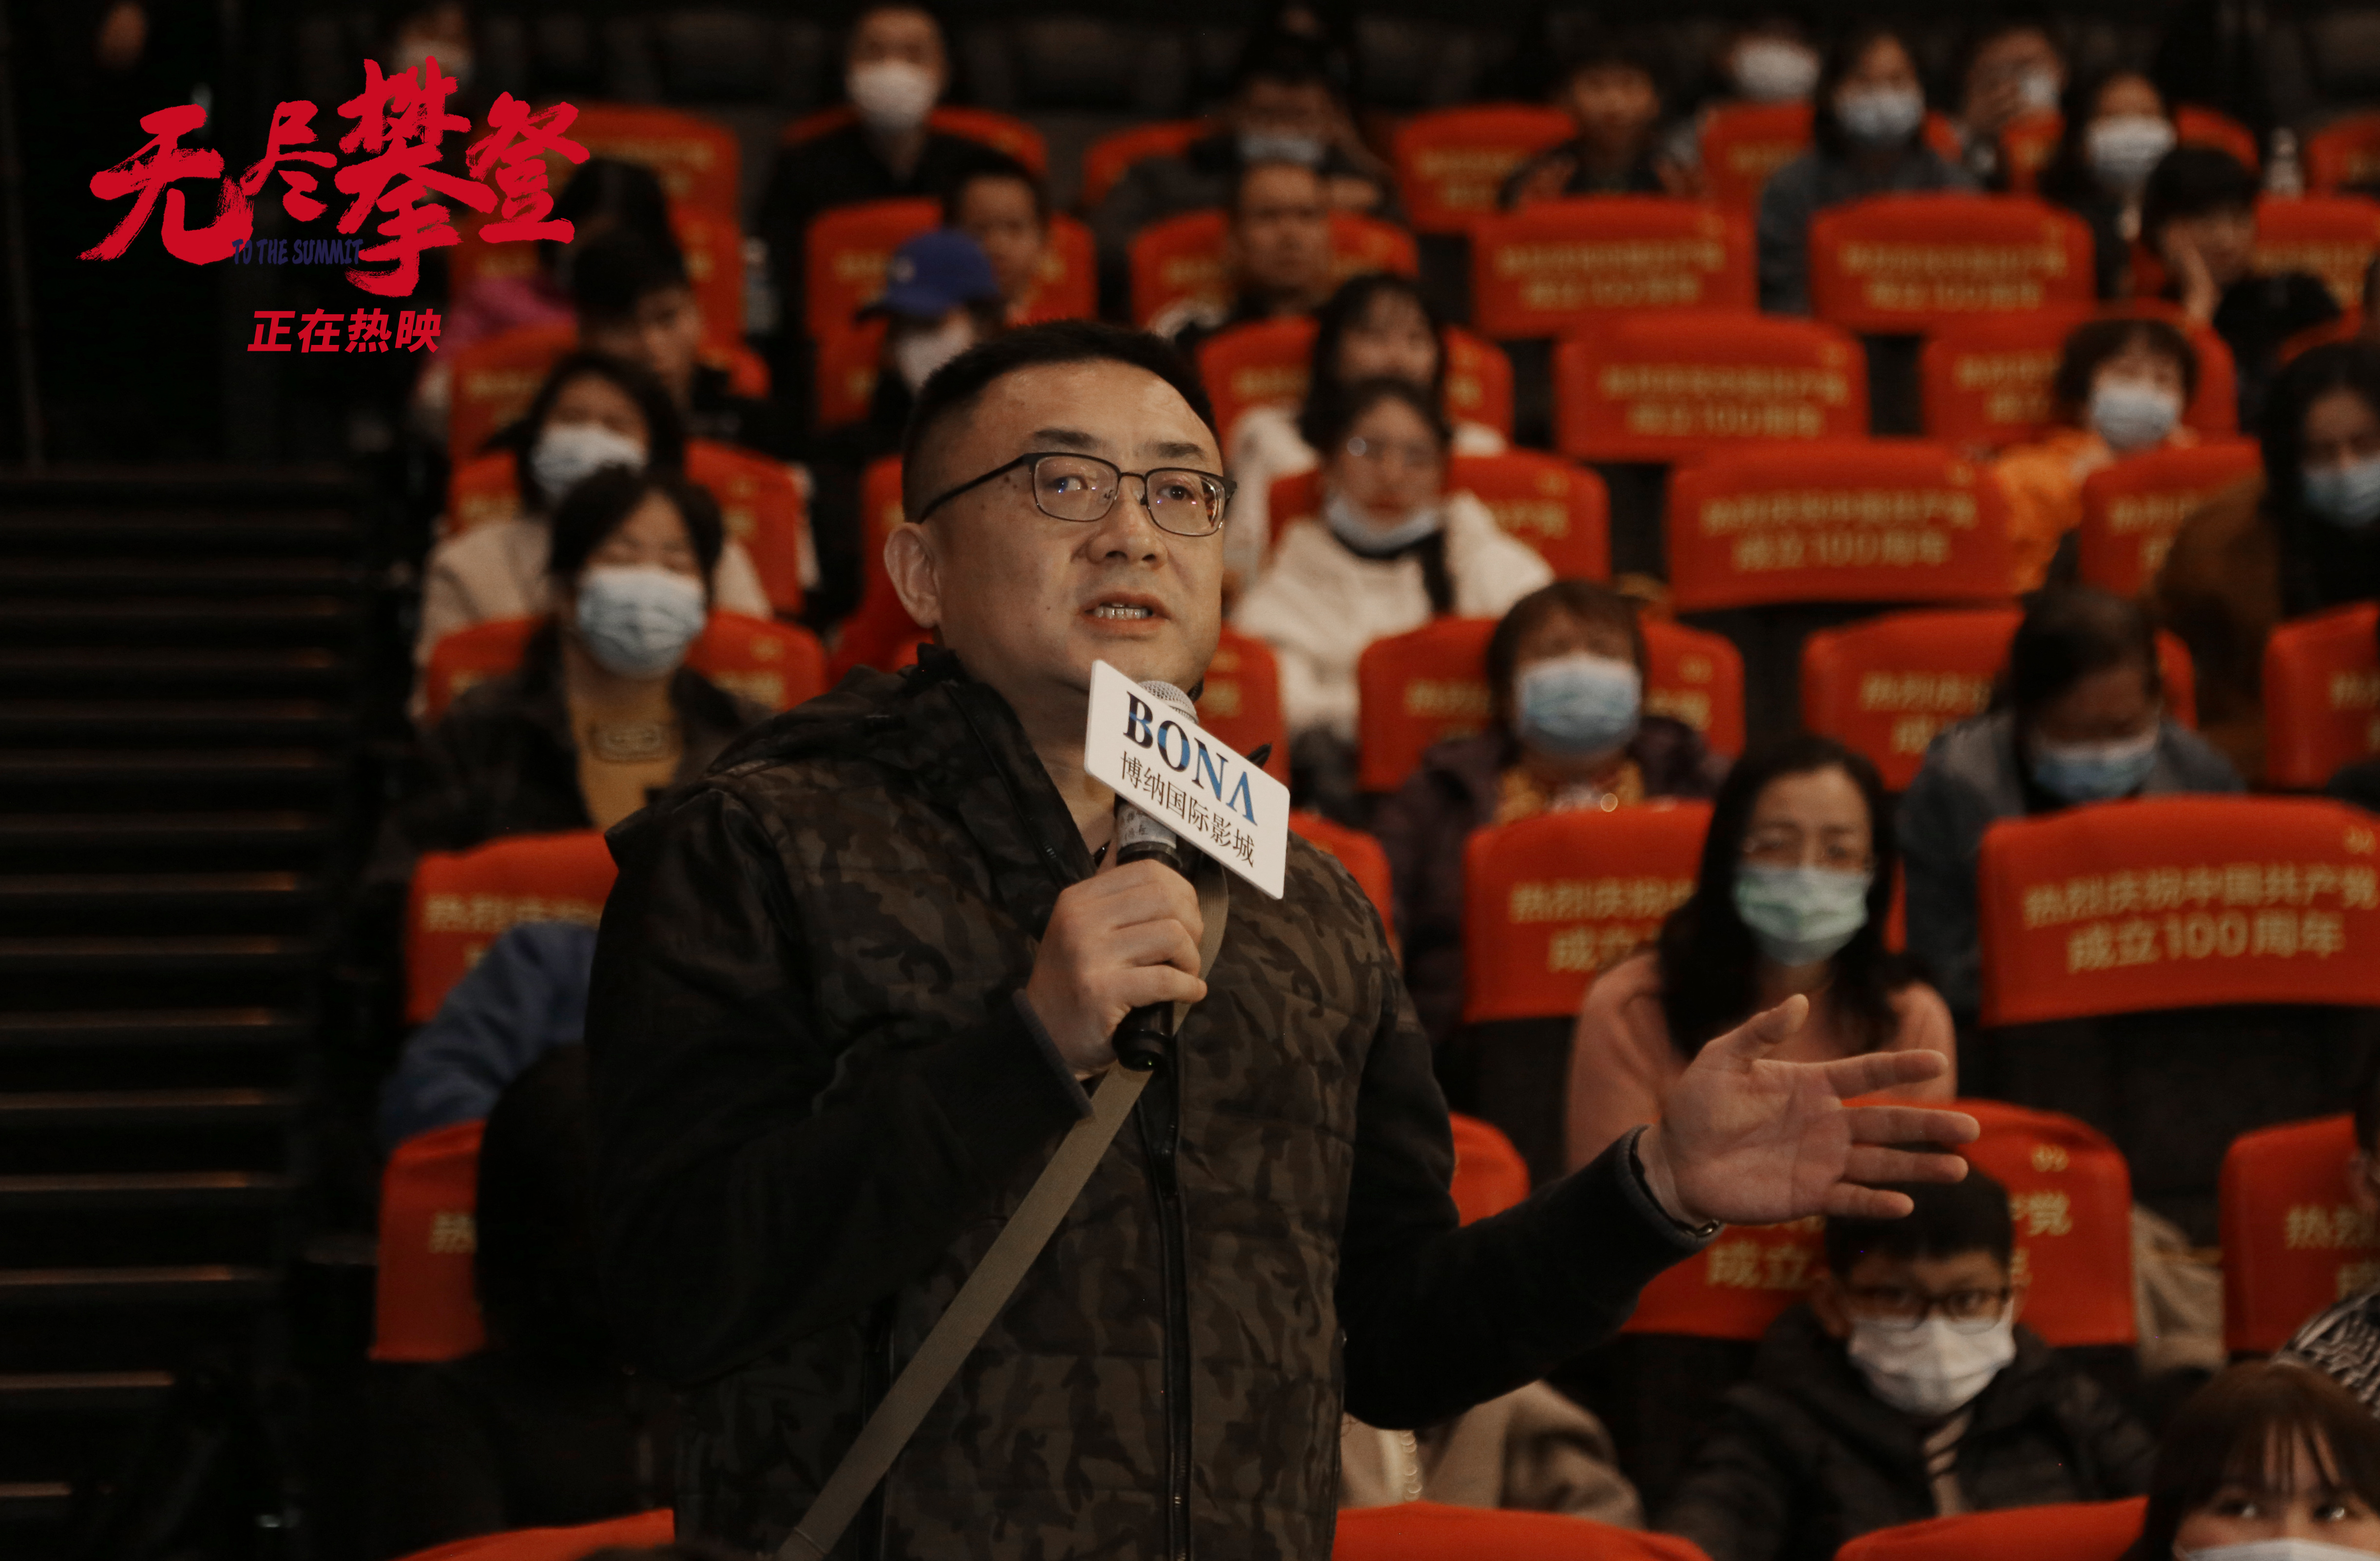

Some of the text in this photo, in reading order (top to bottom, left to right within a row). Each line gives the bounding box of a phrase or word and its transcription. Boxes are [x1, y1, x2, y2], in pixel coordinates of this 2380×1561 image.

[1120, 751, 1254, 868] 博纳国际影城
[1123, 691, 1257, 826] BONA
[2067, 909, 2345, 974] 成立100周年
